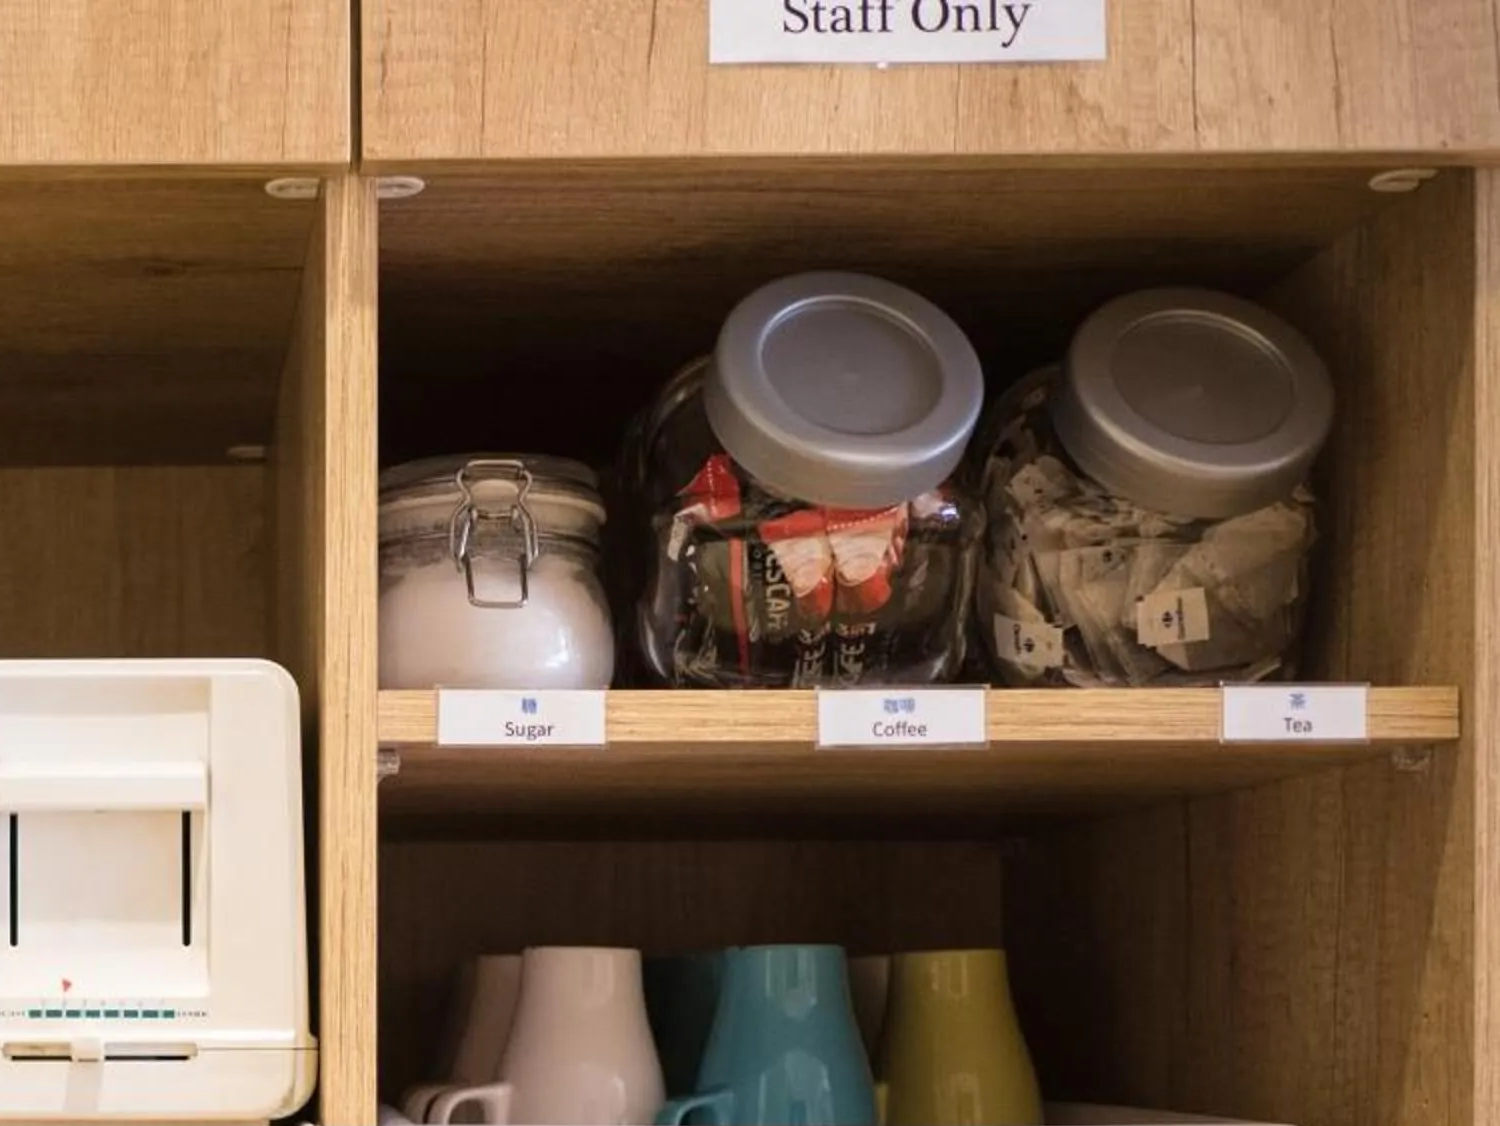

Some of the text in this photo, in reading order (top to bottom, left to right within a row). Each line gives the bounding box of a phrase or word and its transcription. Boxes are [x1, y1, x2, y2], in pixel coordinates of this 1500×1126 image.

[783, 0, 1031, 48] Staff Only
[883, 698, 916, 713] 咖啡
[505, 722, 555, 741] Sugar
[872, 721, 928, 737] Coffee
[1284, 717, 1313, 733] Tea
